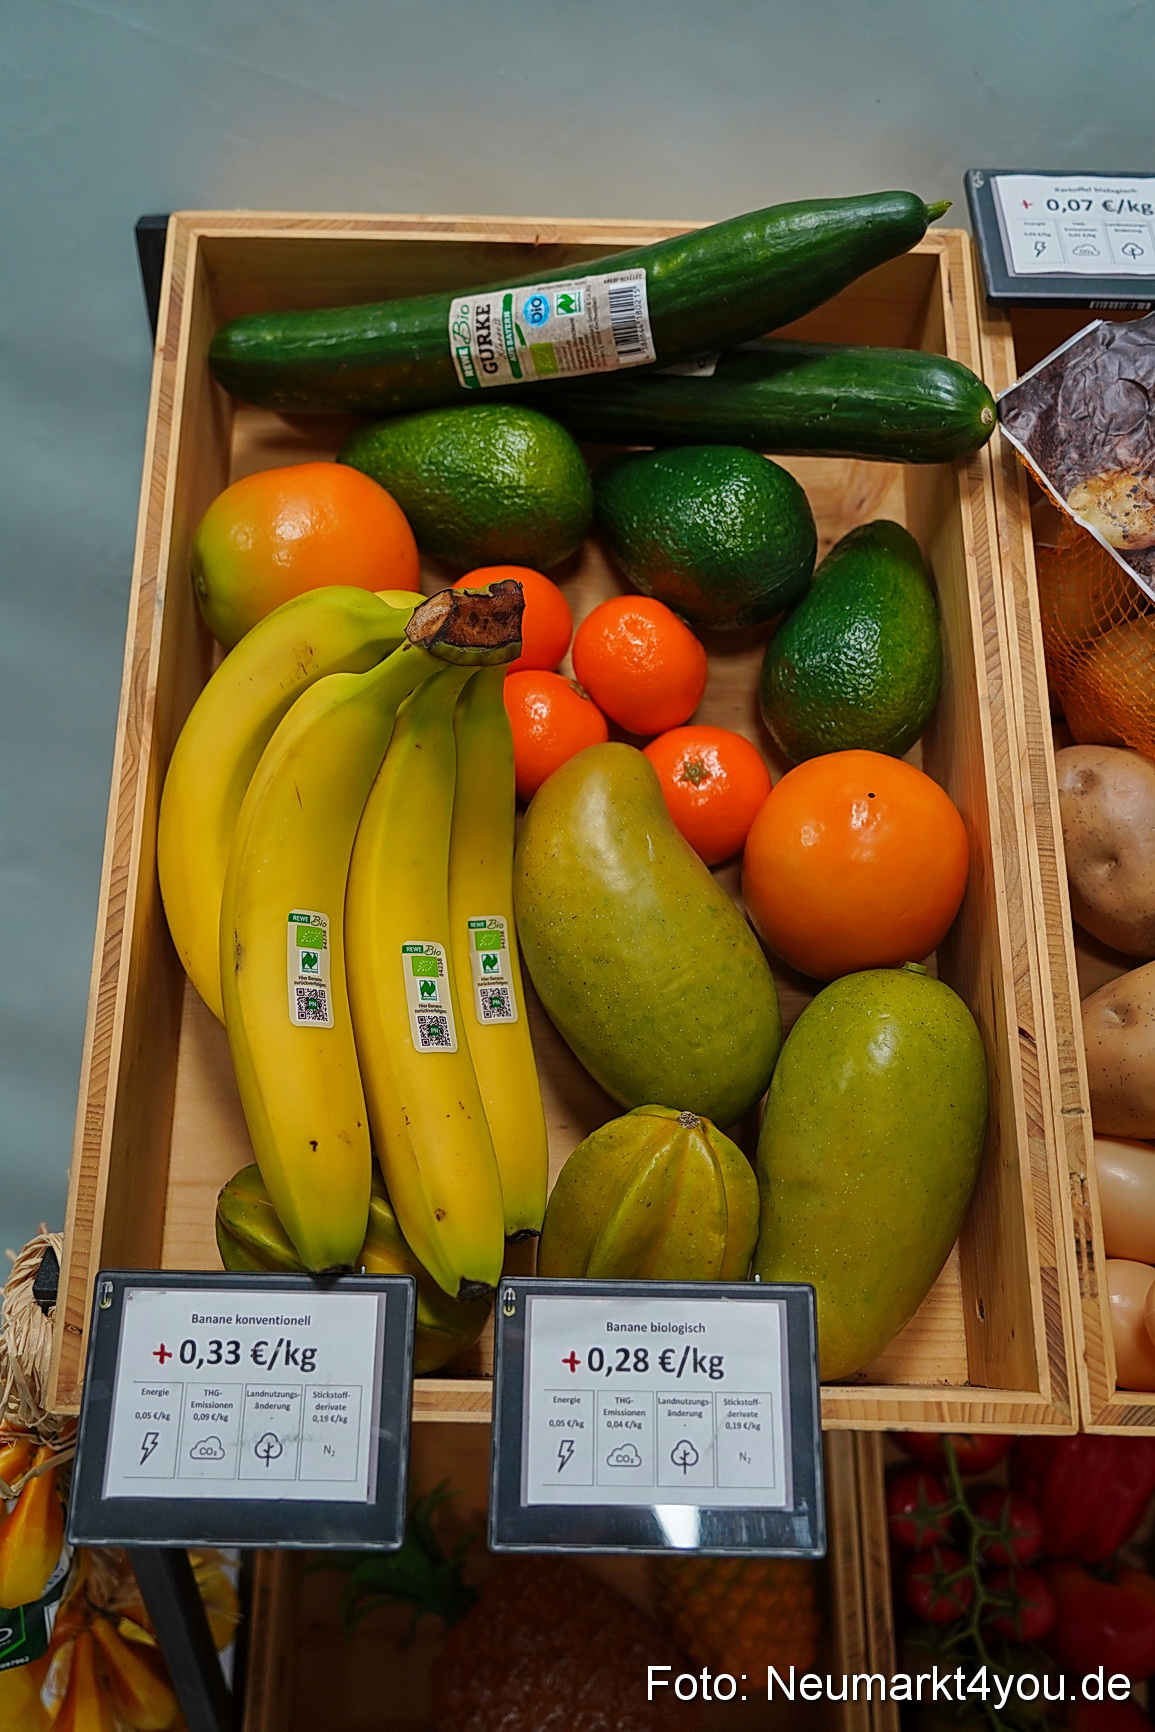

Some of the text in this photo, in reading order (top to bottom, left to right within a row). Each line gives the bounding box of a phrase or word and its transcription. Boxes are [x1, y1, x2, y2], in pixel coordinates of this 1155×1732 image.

[1046, 199, 1093, 213] 0,07
[1101, 199, 1154, 215] €/kg
[531, 298, 542, 324] bio
[452, 305, 474, 377] REWE Bio
[476, 304, 498, 374] GURKE
[504, 311, 517, 362] AUS BAYERN
[292, 915, 327, 928] REWE Bio
[487, 919, 504, 930] Bio
[425, 945, 441, 957] Bio
[191, 1313, 311, 1326] Banane konventionell
[606, 1321, 706, 1335] Banane biologisch
[153, 1338, 317, 1372] + 0,33 €/kg
[562, 1345, 724, 1379] + 0,28 €/kg
[141, 1388, 170, 1398] Energie
[203, 1389, 223, 1397] THG-
[246, 1390, 301, 1400] Landnutzungs-
[312, 1390, 351, 1399] Stickstoff-
[191, 1400, 233, 1410] Emissionen
[553, 1395, 581, 1405] Energie
[615, 1397, 634, 1405] THG-
[657, 1397, 712, 1407] Landnutzungs-
[723, 1398, 761, 1407] Stickstoff-
[254, 1401, 291, 1411] änderung
[315, 1403, 347, 1411] derivate
[135, 1412, 171, 1422] 0,05 €/kg
[603, 1408, 646, 1417] Emissionen
[667, 1409, 703, 1419] änderung
[727, 1410, 758, 1418] derivate
[193, 1413, 229, 1423] 0,09 €/kg
[312, 1414, 348, 1425] 0,19 €/kg
[549, 1419, 584, 1429] 0,05 €/kg
[606, 1420, 642, 1431] 0,04 €/kg
[725, 1421, 761, 1432] 0,19 €/kg
